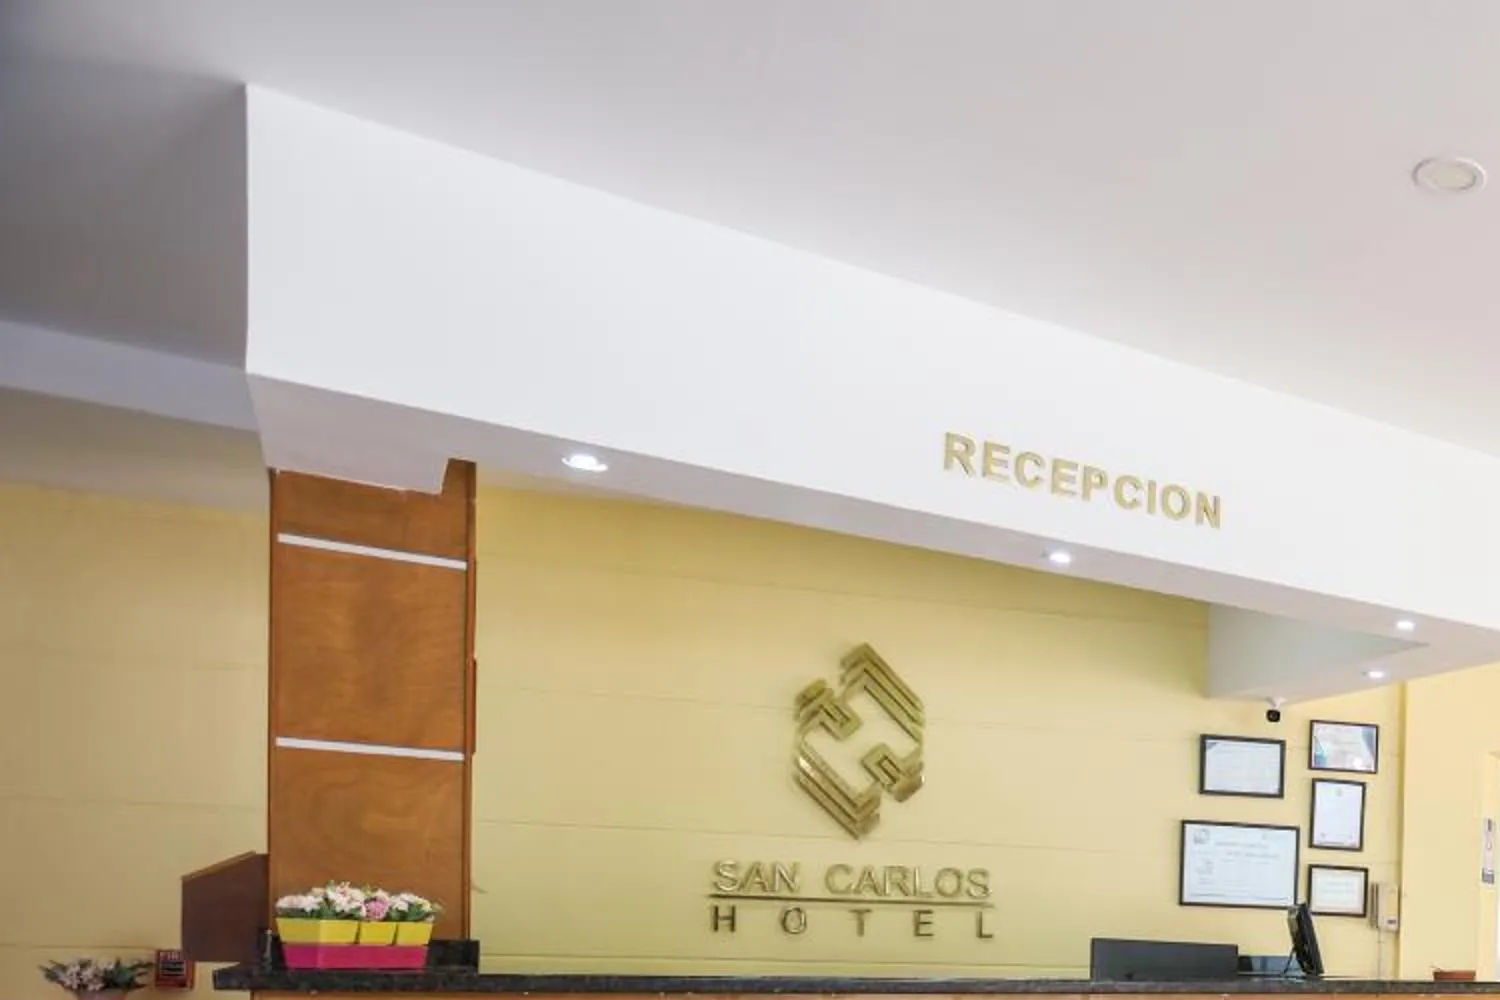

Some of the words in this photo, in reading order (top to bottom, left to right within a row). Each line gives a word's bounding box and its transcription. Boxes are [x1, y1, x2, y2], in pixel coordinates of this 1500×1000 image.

[943, 432, 1221, 529] RECEPCION
[712, 859, 799, 894] SAN
[823, 863, 993, 899] CARLOS
[712, 905, 994, 939] HOTEL
